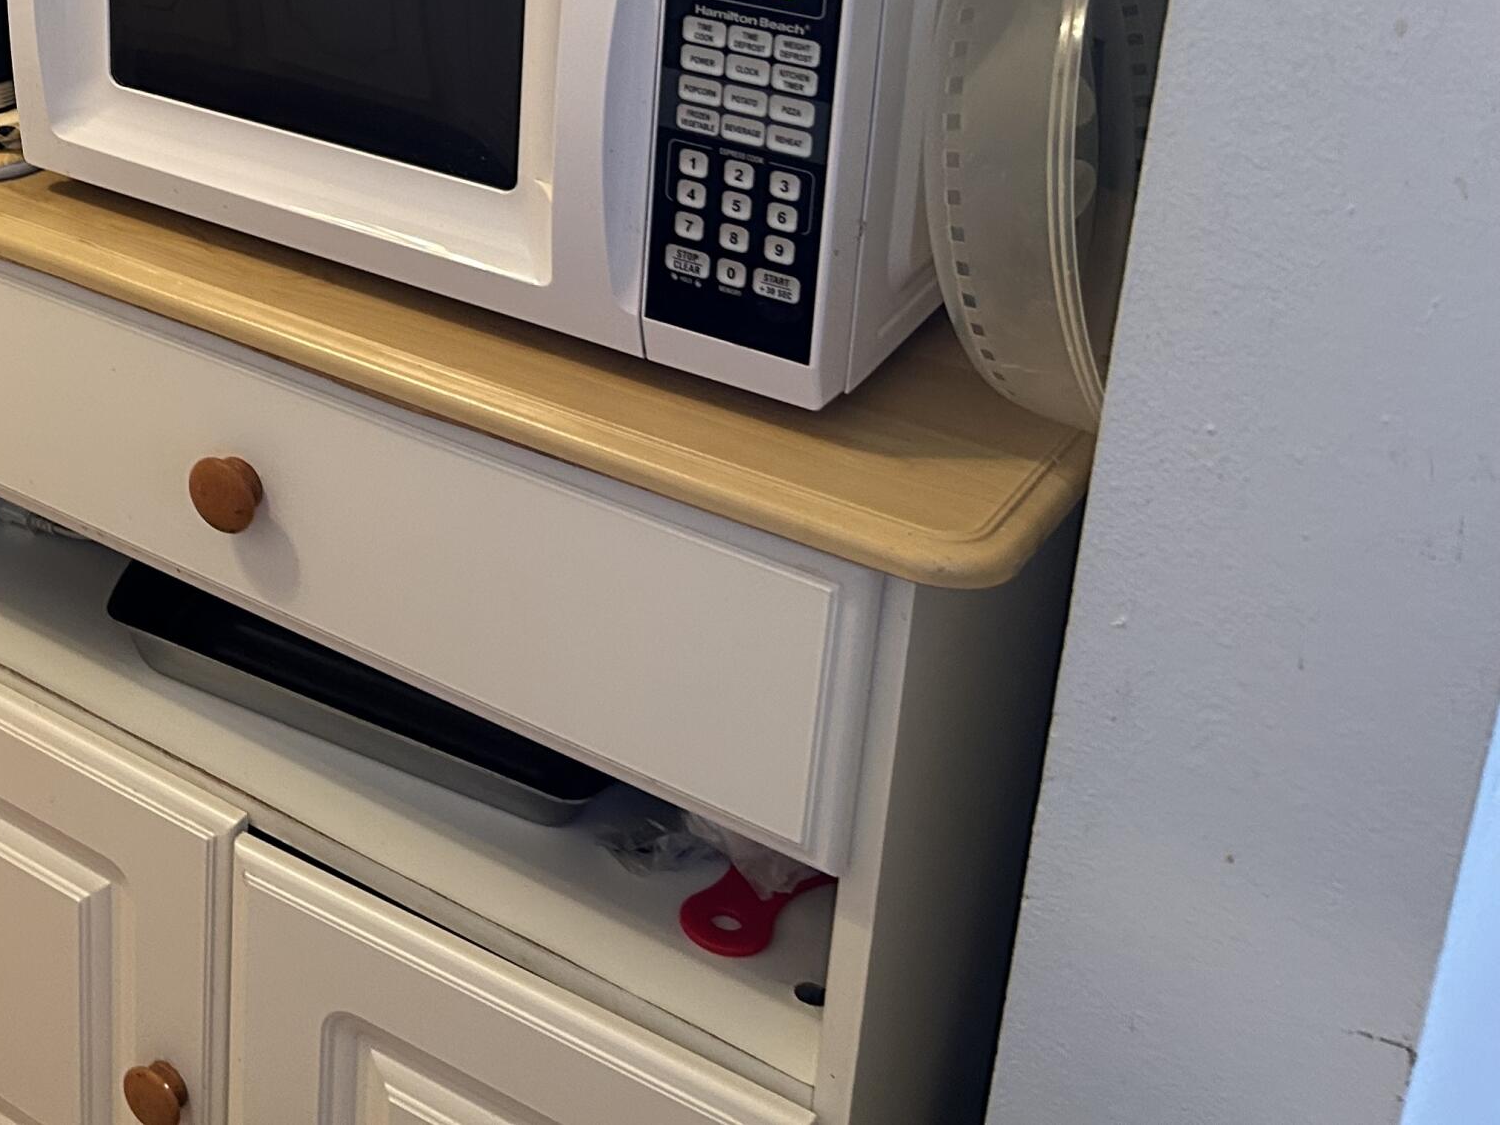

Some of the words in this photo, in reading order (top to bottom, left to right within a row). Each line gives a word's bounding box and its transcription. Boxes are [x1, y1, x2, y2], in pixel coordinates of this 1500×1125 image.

[694, 4, 758, 26] Hamilton
[759, 17, 805, 35] Beach
[684, 84, 717, 98] POPCORN
[688, 157, 697, 170] 1
[734, 168, 743, 182] 2
[780, 180, 789, 193] 3
[686, 188, 696, 201] 4
[731, 199, 741, 212] 5
[777, 211, 787, 224] 6
[684, 220, 694, 232] 7
[729, 232, 739, 245] 8
[676, 249, 699, 261] STOP
[774, 244, 784, 257] 9
[673, 260, 701, 275] CLEAR
[726, 267, 736, 280] 0
[763, 273, 790, 287] START
